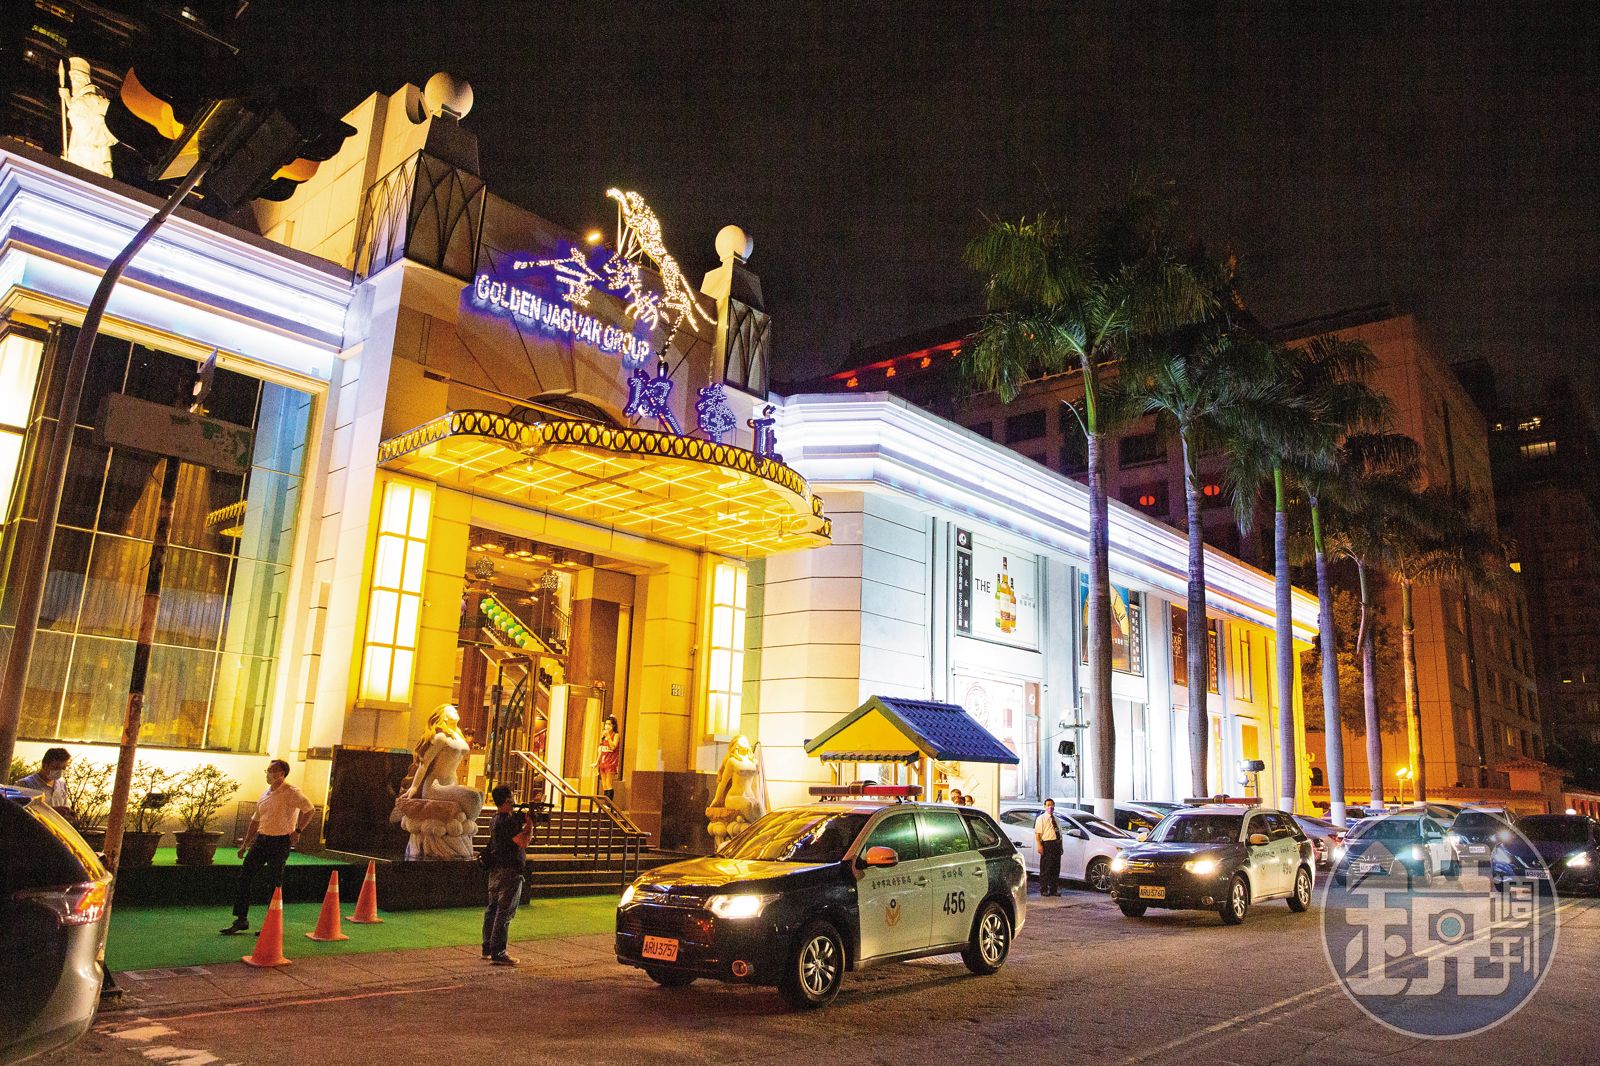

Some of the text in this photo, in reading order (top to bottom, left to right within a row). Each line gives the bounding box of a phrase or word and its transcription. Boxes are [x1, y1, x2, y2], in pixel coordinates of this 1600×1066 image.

[476, 273, 650, 363] GOLDEN JAGUAR GROUP
[975, 577, 991, 594] THE
[943, 890, 966, 915] 456
